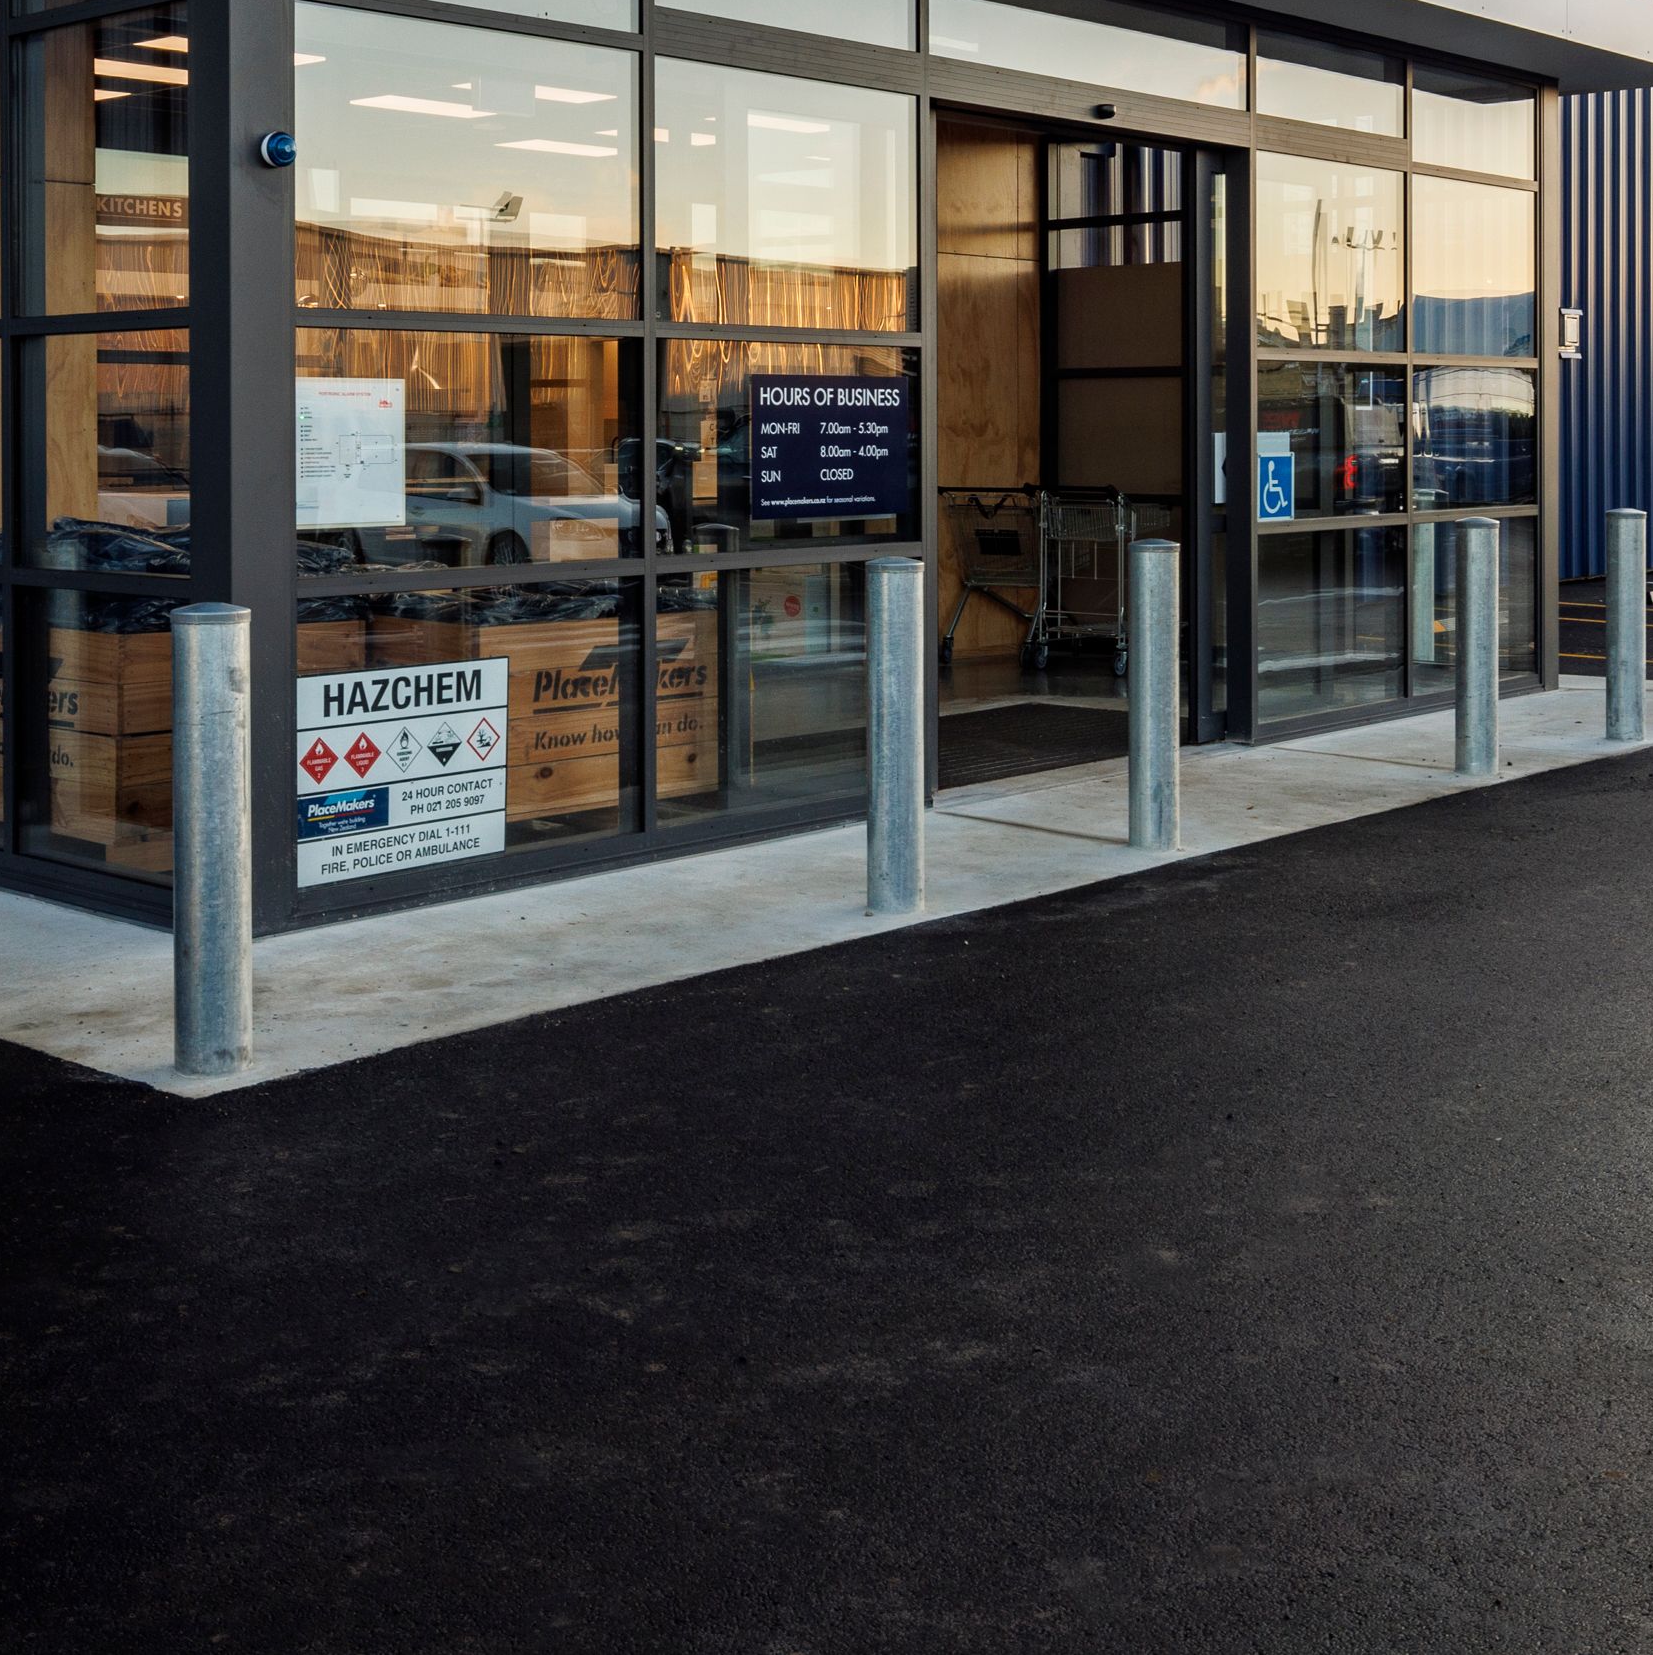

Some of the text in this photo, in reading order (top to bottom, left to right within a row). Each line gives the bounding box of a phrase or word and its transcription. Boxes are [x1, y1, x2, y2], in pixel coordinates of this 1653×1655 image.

[96, 196, 183, 218] KITCHENS
[760, 387, 900, 407] HOURS OF BUSINESS
[761, 422, 800, 435] MON-FRI
[820, 422, 851, 435] 7.00am
[858, 422, 889, 437] 5.30pm
[761, 446, 778, 459] SAT
[820, 445, 851, 458] 8.00am
[858, 445, 889, 460] 4.00pm
[761, 468, 854, 483] SUN CLOSED
[760, 498, 771, 507] See
[834, 495, 853, 504] seasonal
[323, 668, 482, 718] HAZCHEM
[533, 662, 707, 703] Placekers
[534, 731, 587, 751] Know
[591, 724, 619, 744] ho
[677, 713, 704, 733] do.
[401, 778, 493, 802] 24 HOUR CONTACT
[307, 798, 375, 818] PlaceMakers
[410, 794, 485, 815] PH 021 205 9097
[331, 824, 471, 857] IN EMERGENCY DIAL 1-111
[321, 837, 481, 876] FIRE, POLICE OR AMBULANCE
